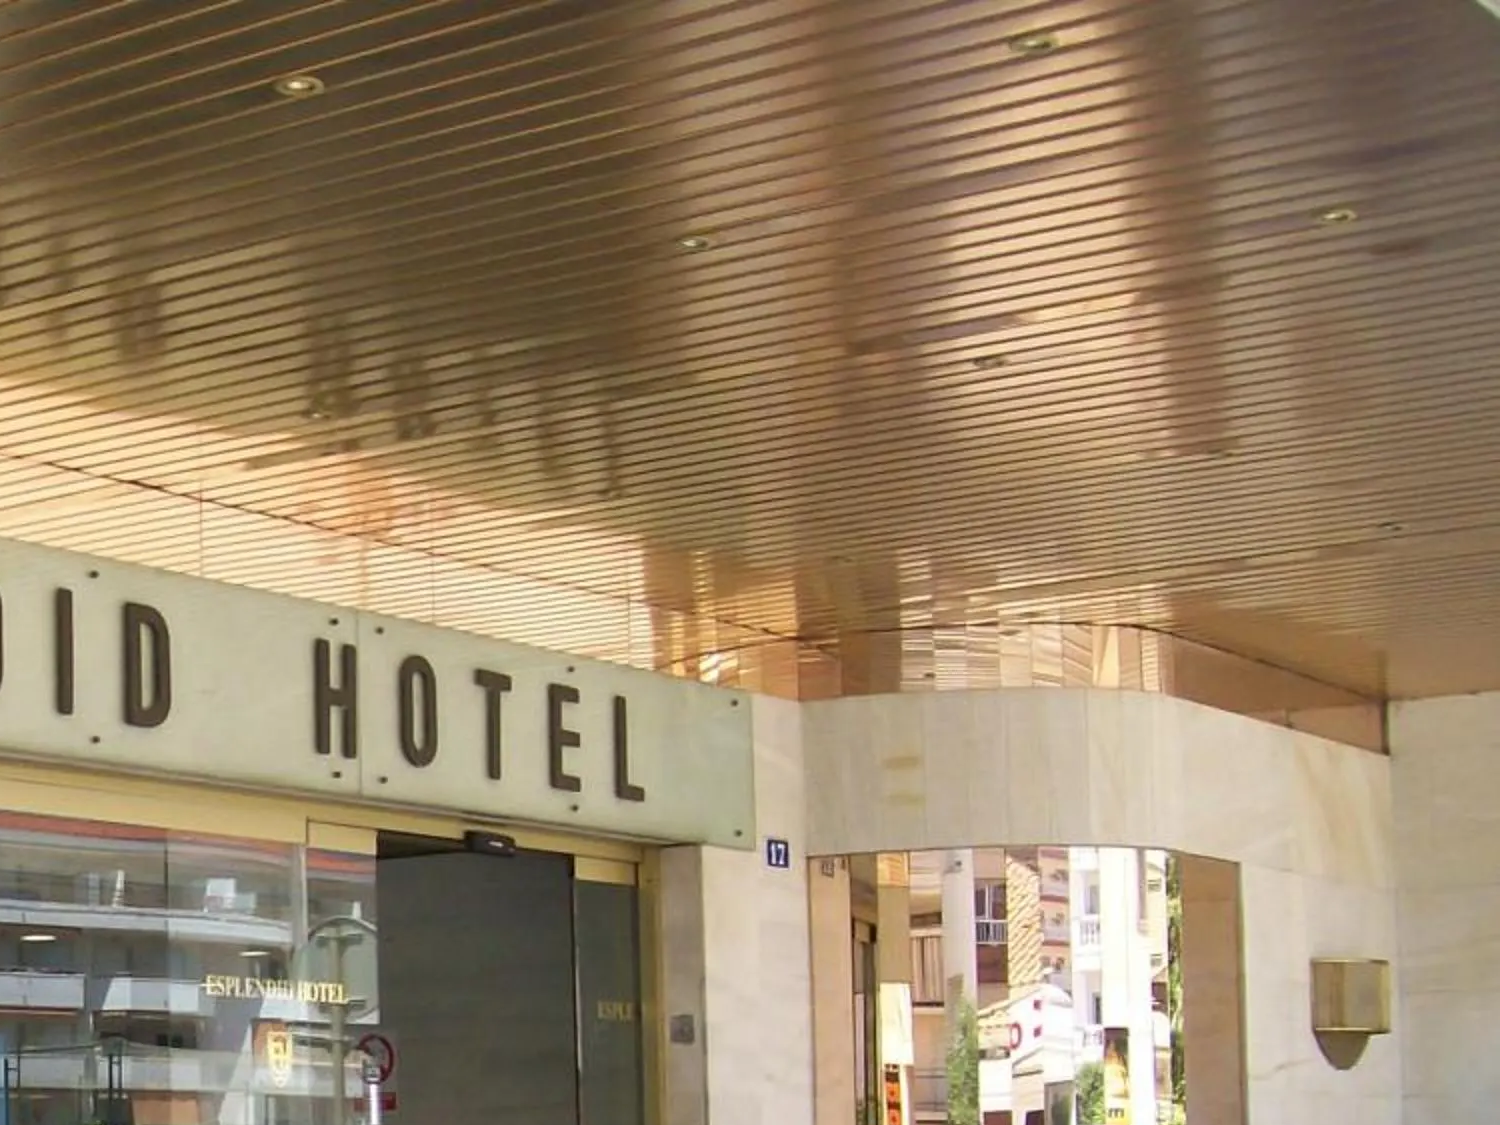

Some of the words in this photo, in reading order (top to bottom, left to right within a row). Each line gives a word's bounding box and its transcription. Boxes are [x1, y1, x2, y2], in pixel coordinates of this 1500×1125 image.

[314, 638, 645, 801] HOTEL
[771, 843, 786, 865] 17
[206, 974, 294, 1000] ESPLENDID
[297, 980, 349, 1004] HOTEL
